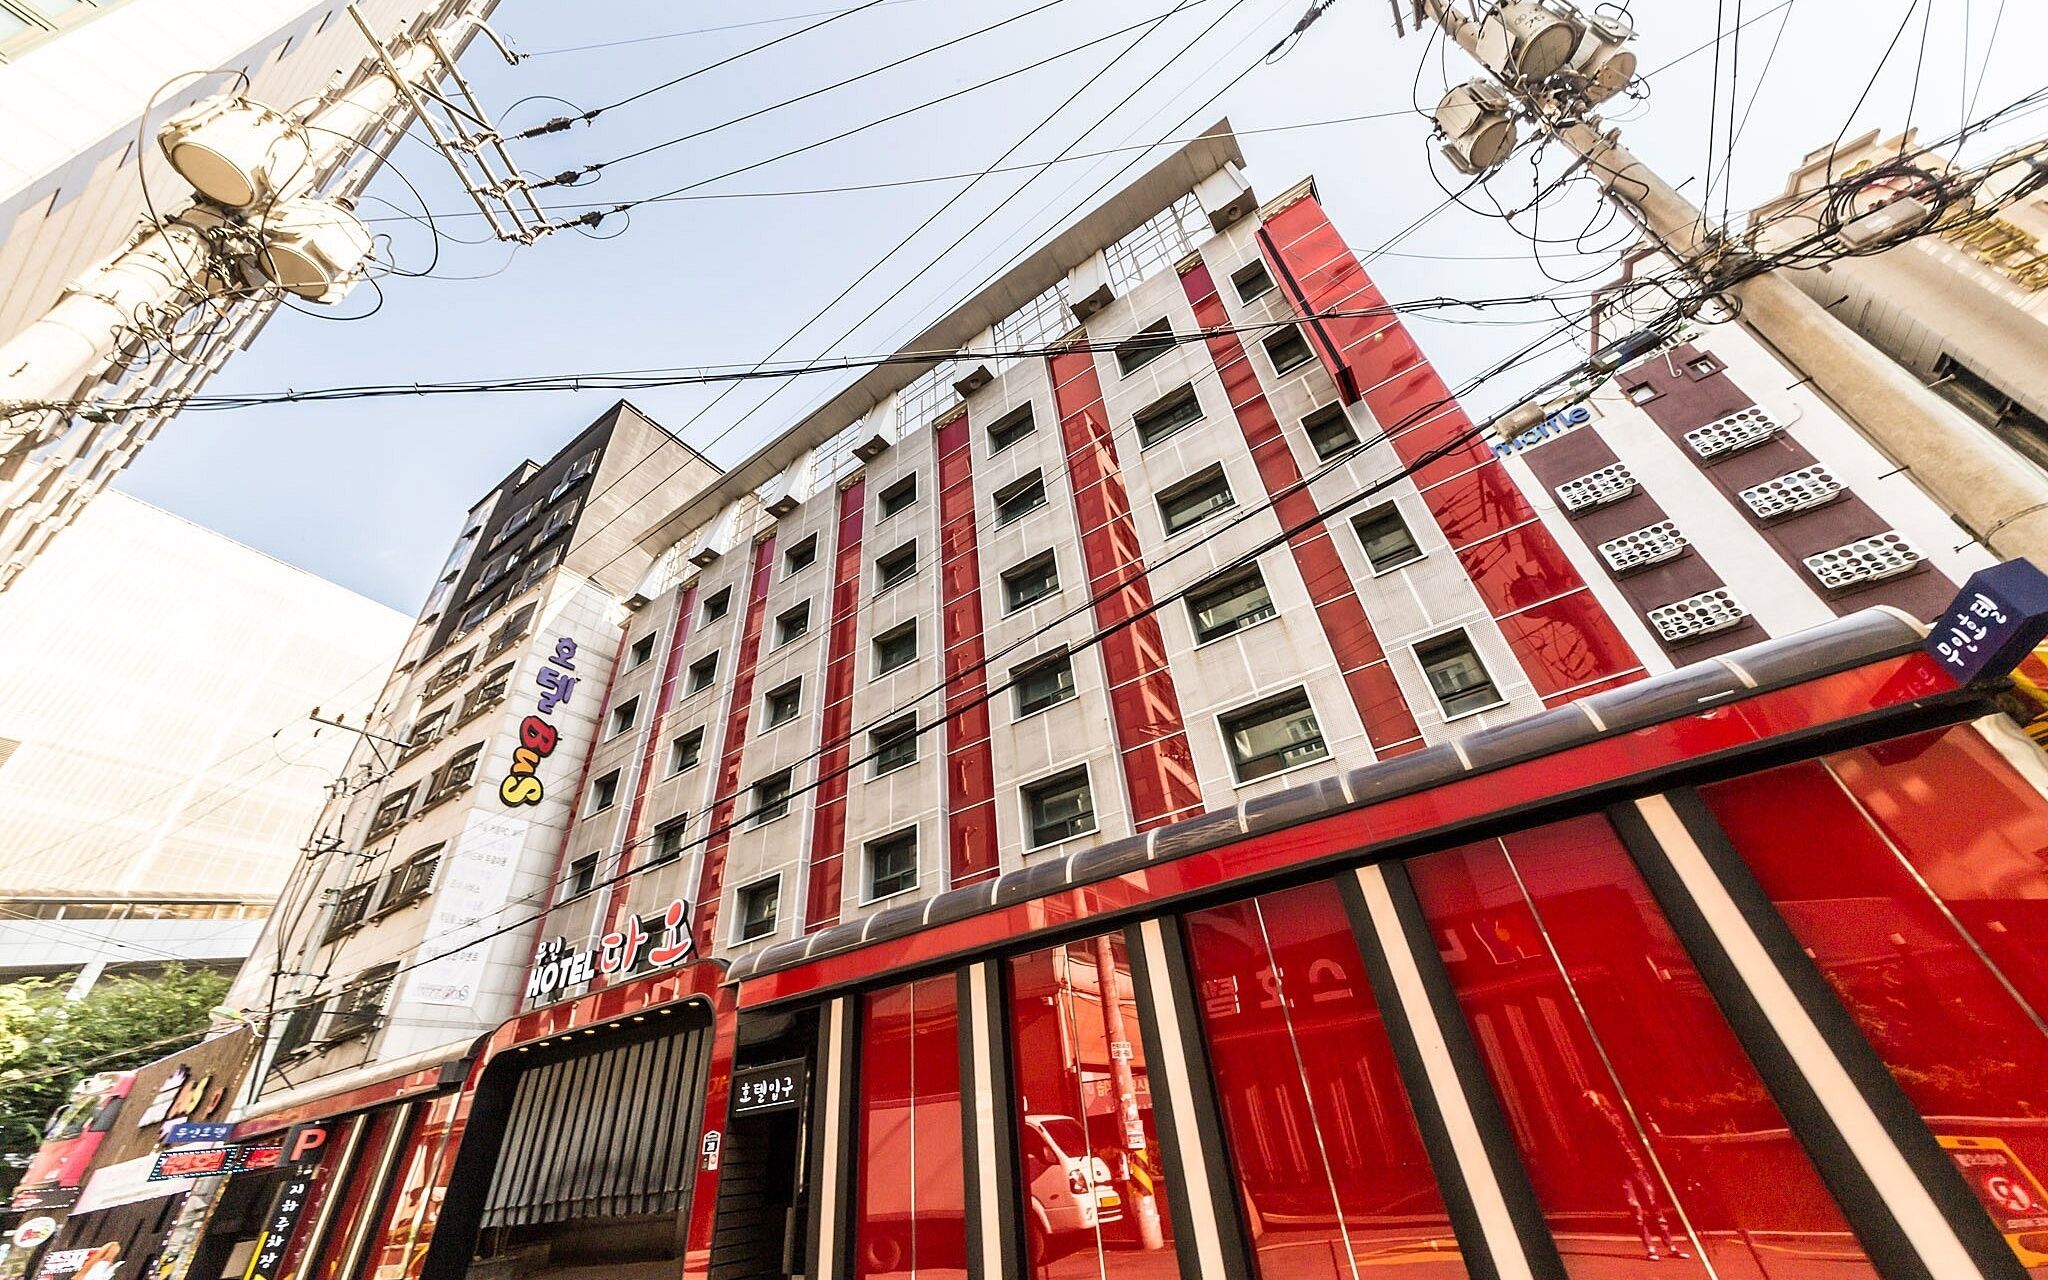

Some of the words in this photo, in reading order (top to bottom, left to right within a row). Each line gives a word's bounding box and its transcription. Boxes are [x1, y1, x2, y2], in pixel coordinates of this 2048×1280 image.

[1937, 592, 2007, 667] 무인호텔
[536, 636, 578, 716] 호텔
[526, 949, 595, 998] HOTEL
[600, 898, 692, 974] 다오
[535, 936, 565, 965] 무인
[739, 1076, 795, 1104] 호텔입구
[289, 1128, 327, 1162] P
[258, 1183, 305, 1269] 지하주차장
